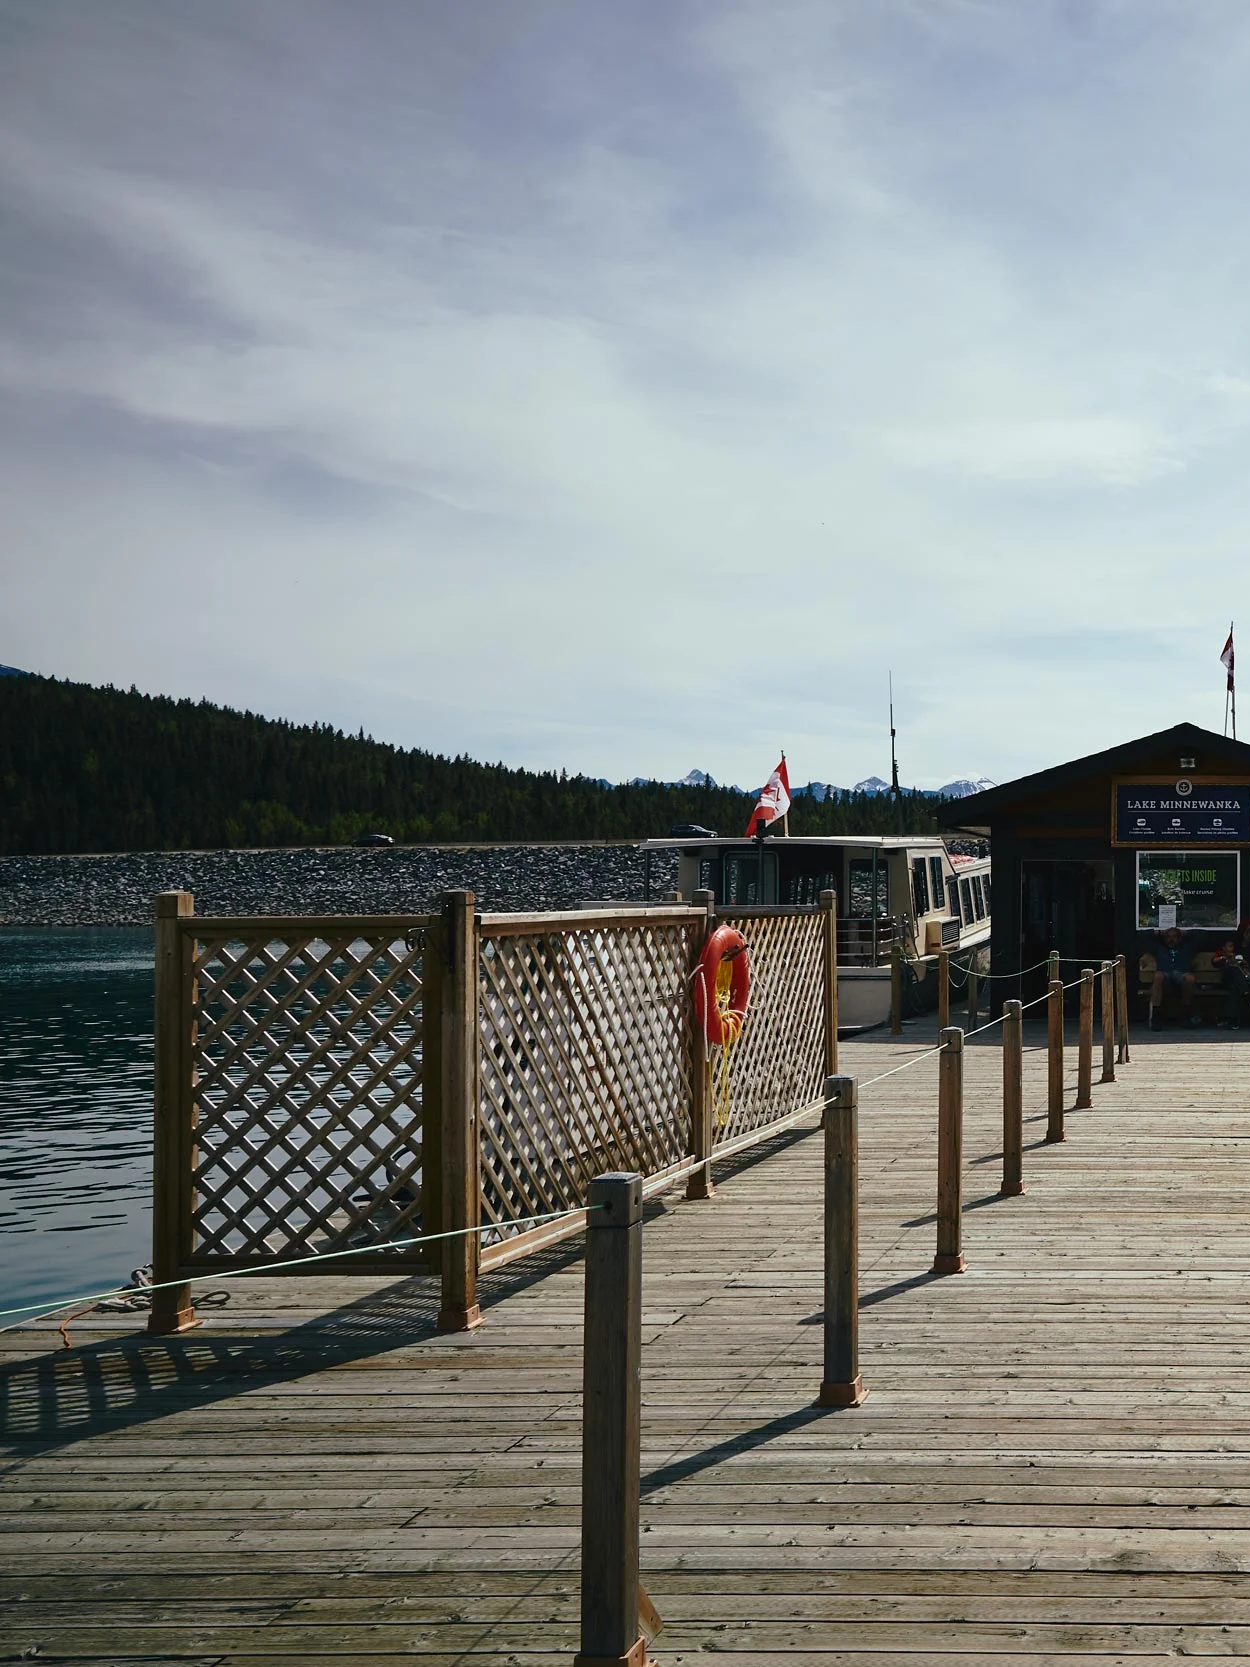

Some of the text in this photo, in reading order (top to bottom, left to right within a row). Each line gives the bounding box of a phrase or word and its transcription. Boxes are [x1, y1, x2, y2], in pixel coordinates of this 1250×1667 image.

[1127, 800, 1241, 809] LAKE MINNEWANKA
[1191, 869, 1217, 882] INSIDE
